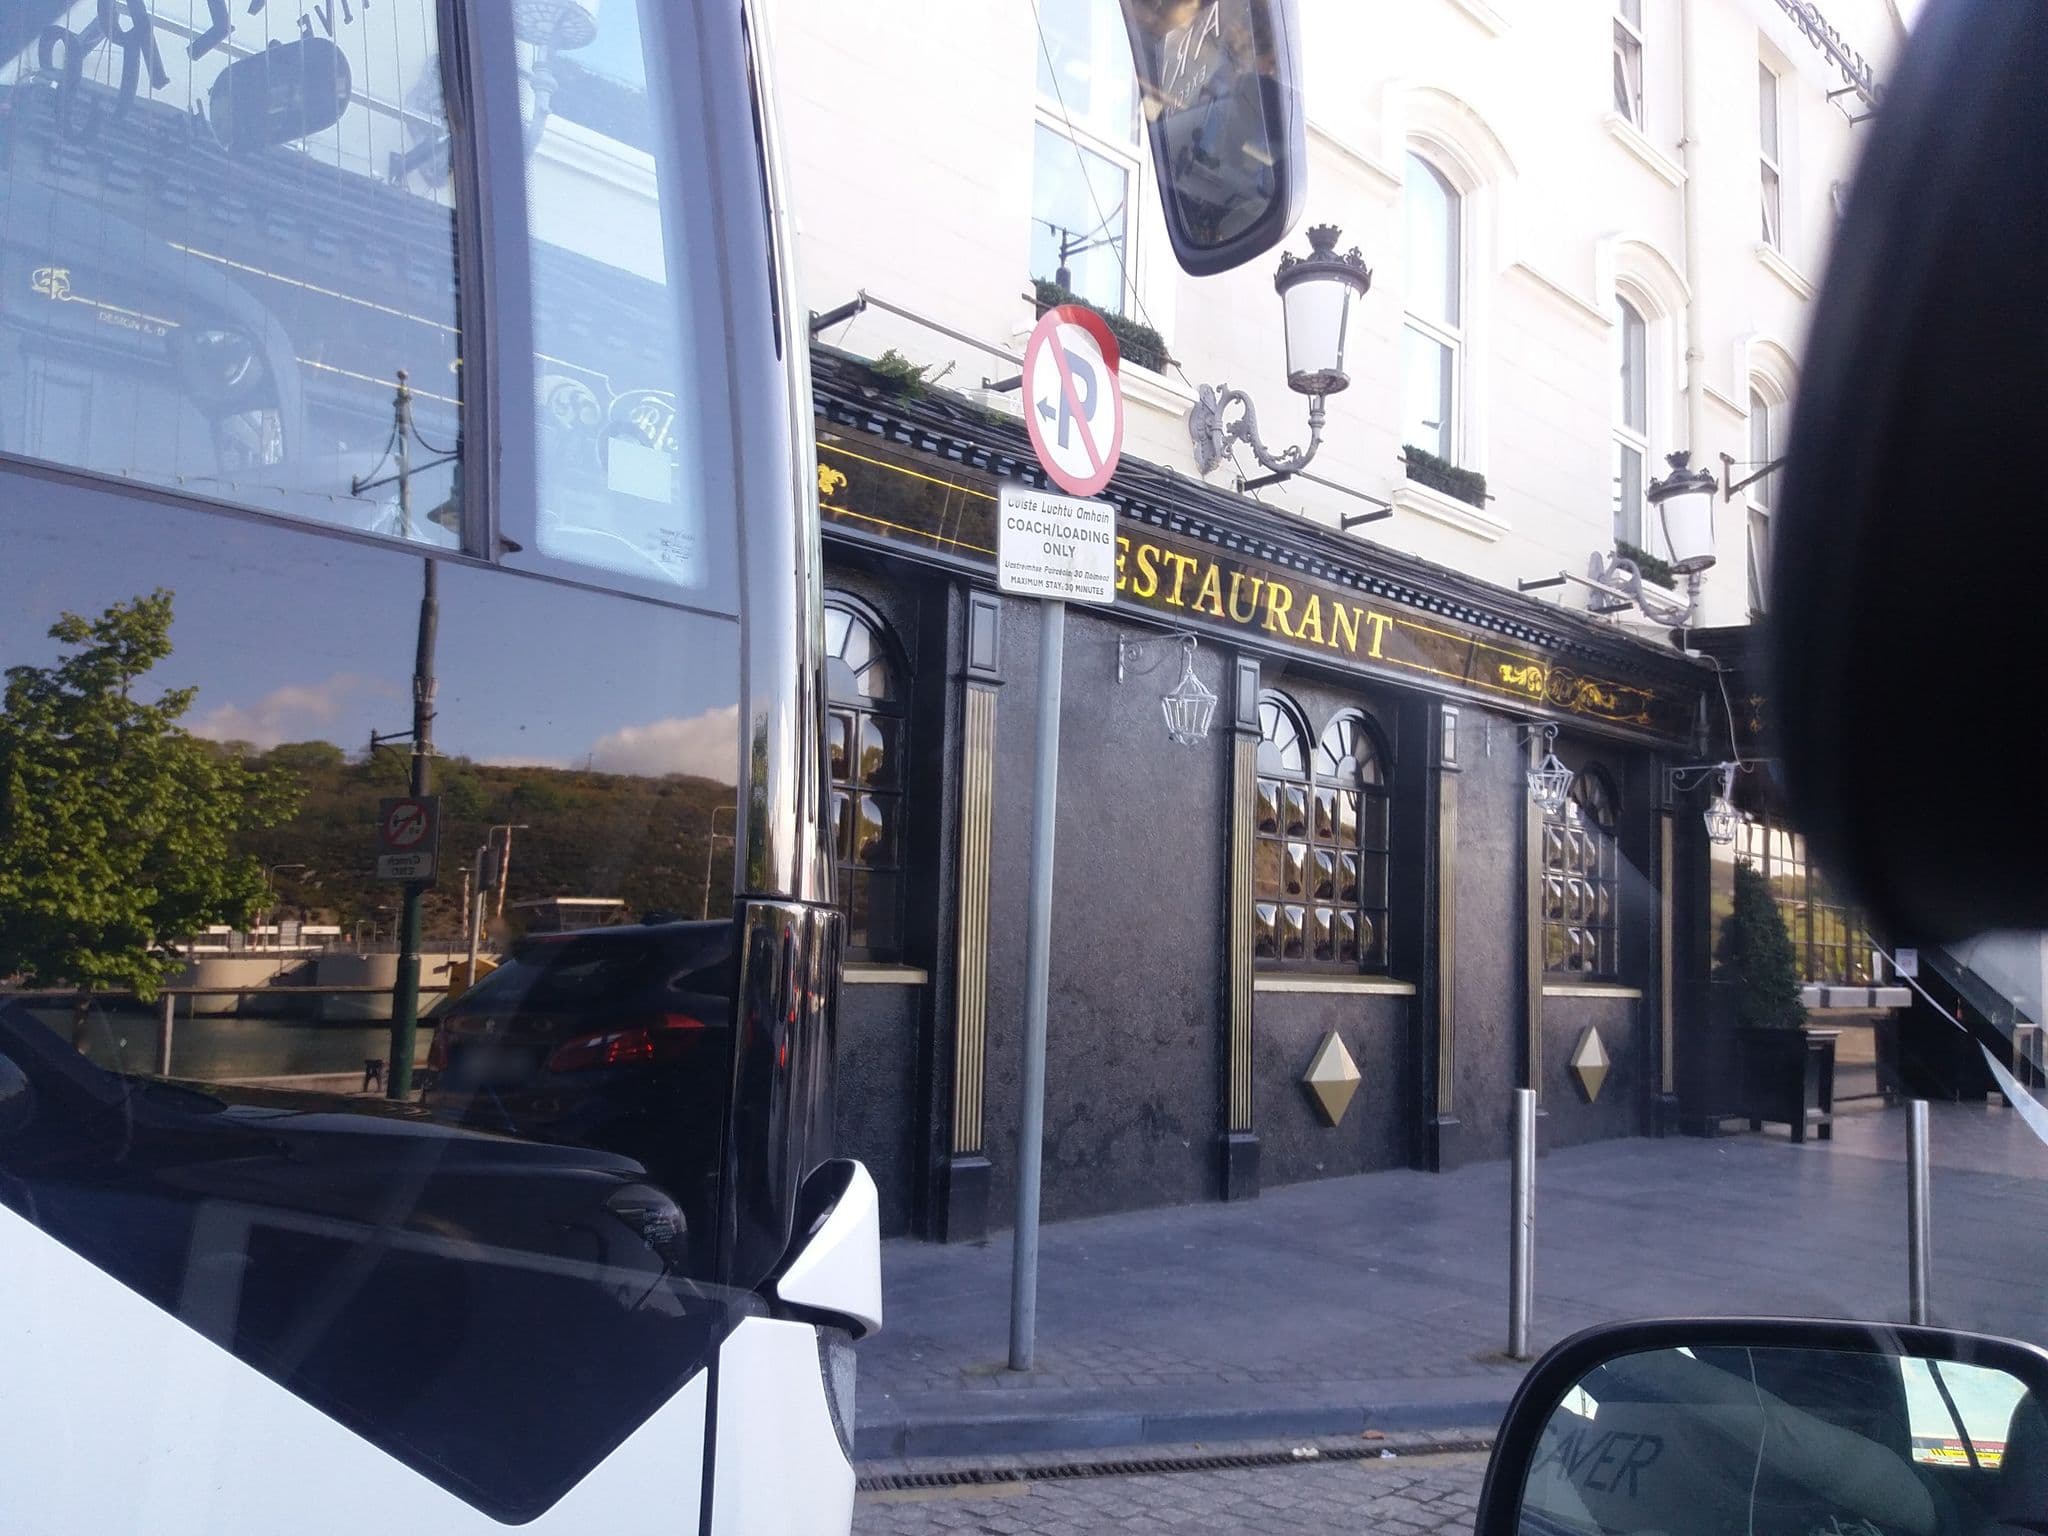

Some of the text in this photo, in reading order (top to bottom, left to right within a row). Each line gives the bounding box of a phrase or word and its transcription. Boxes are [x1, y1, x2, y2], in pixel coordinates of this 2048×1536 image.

[1007, 517, 1110, 545] COACH/LOADING
[1043, 542, 1076, 558] ONLY
[1010, 575, 1044, 587] MAXIMUM
[1075, 585, 1104, 596] MINUTES
